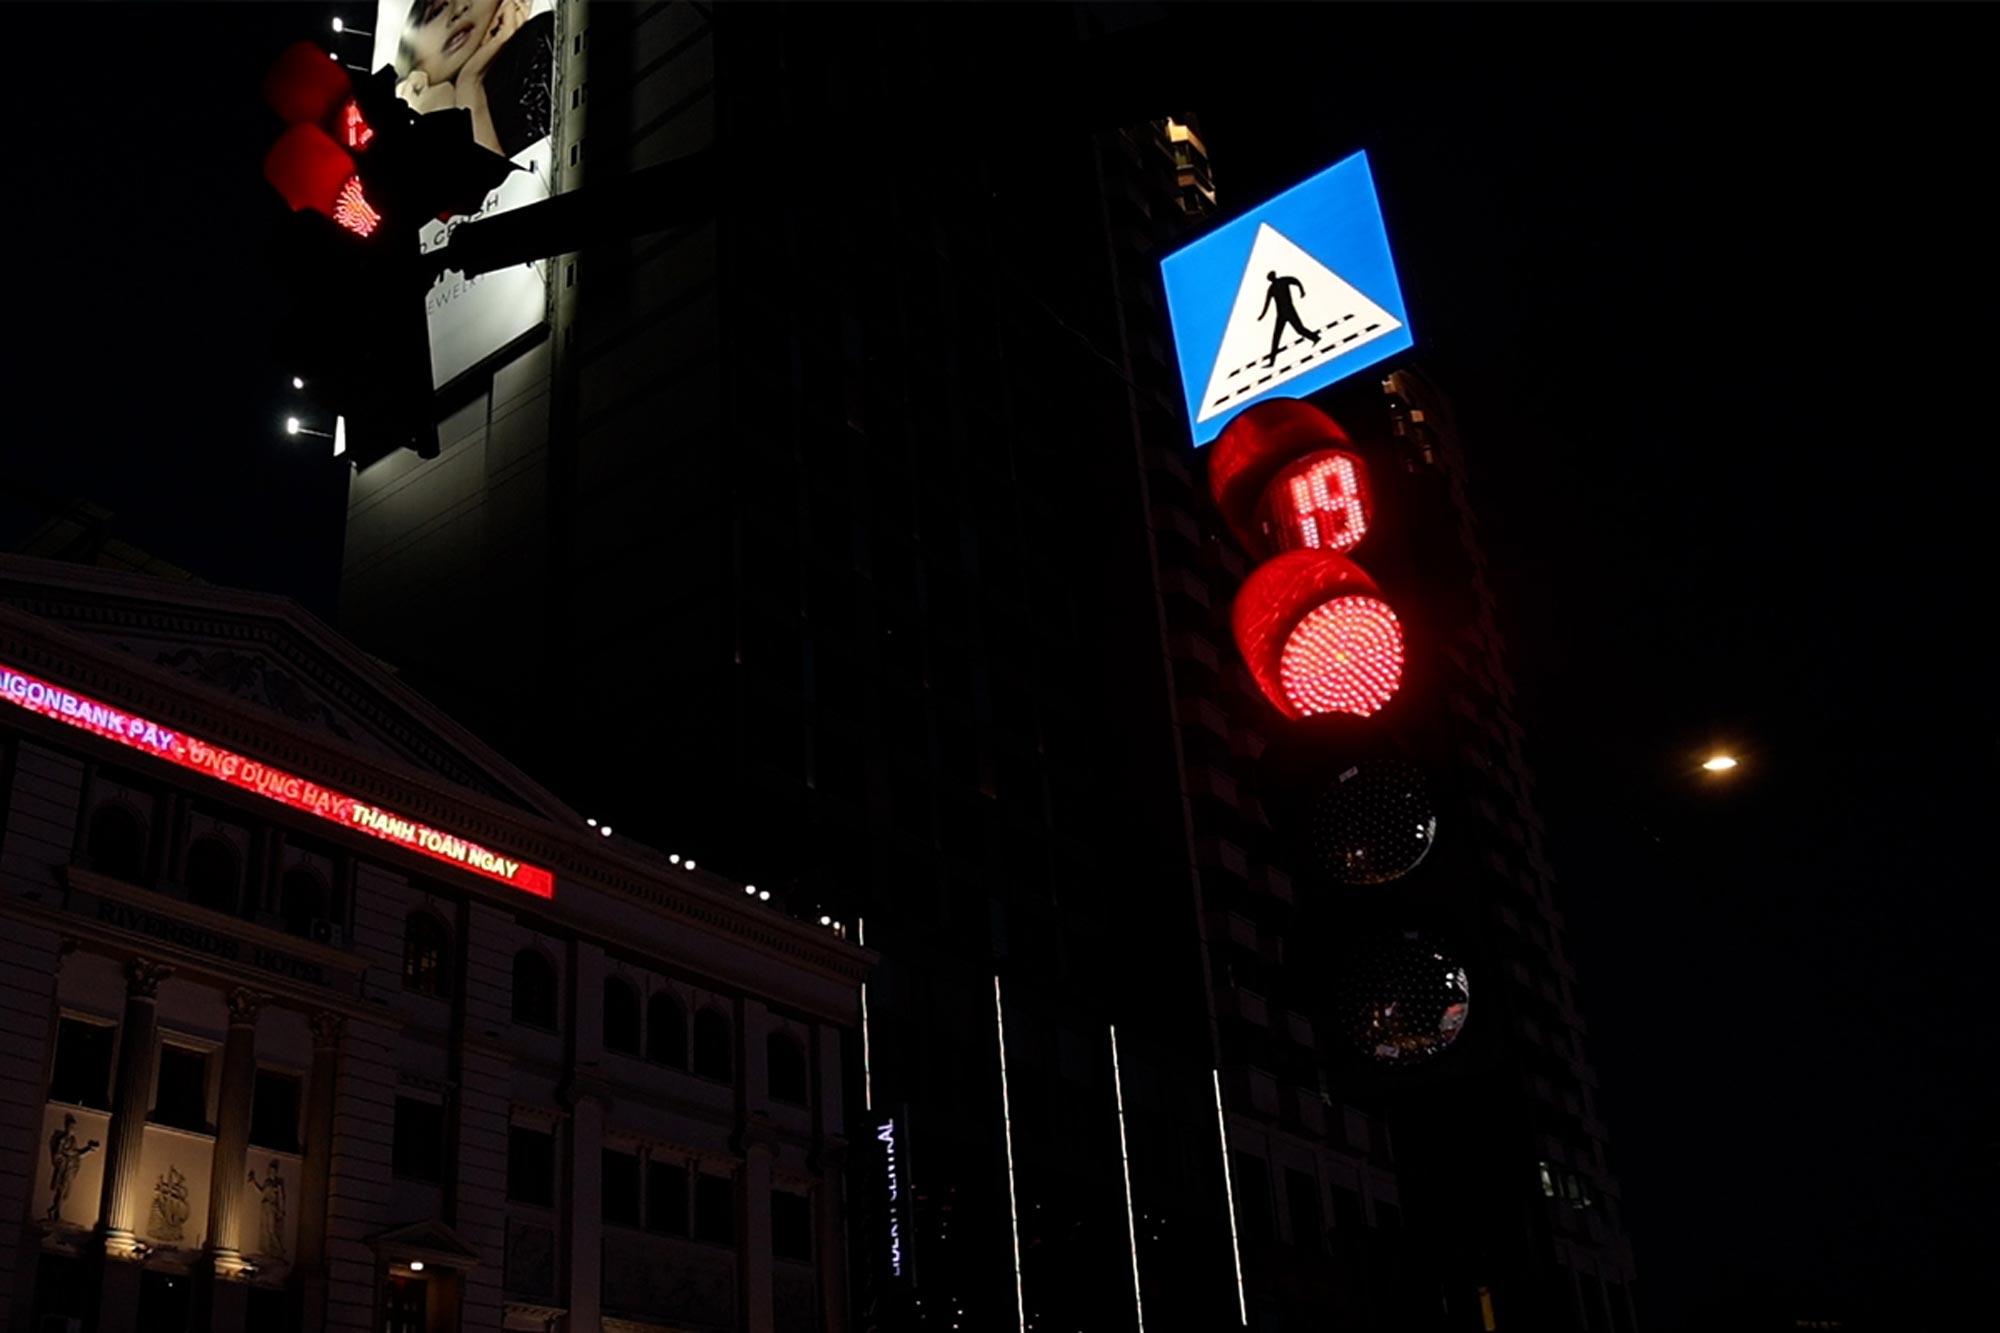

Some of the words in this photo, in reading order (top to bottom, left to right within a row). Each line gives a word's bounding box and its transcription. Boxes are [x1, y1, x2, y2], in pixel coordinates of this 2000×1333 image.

[1290, 456, 1366, 549] 19
[0, 672, 124, 734] IGONBANK
[128, 719, 173, 750] PAY
[352, 804, 416, 841] THANH
[468, 848, 519, 879] NGAY
[98, 902, 240, 960] RIVERSIDE
[254, 944, 332, 987] HOTEL
